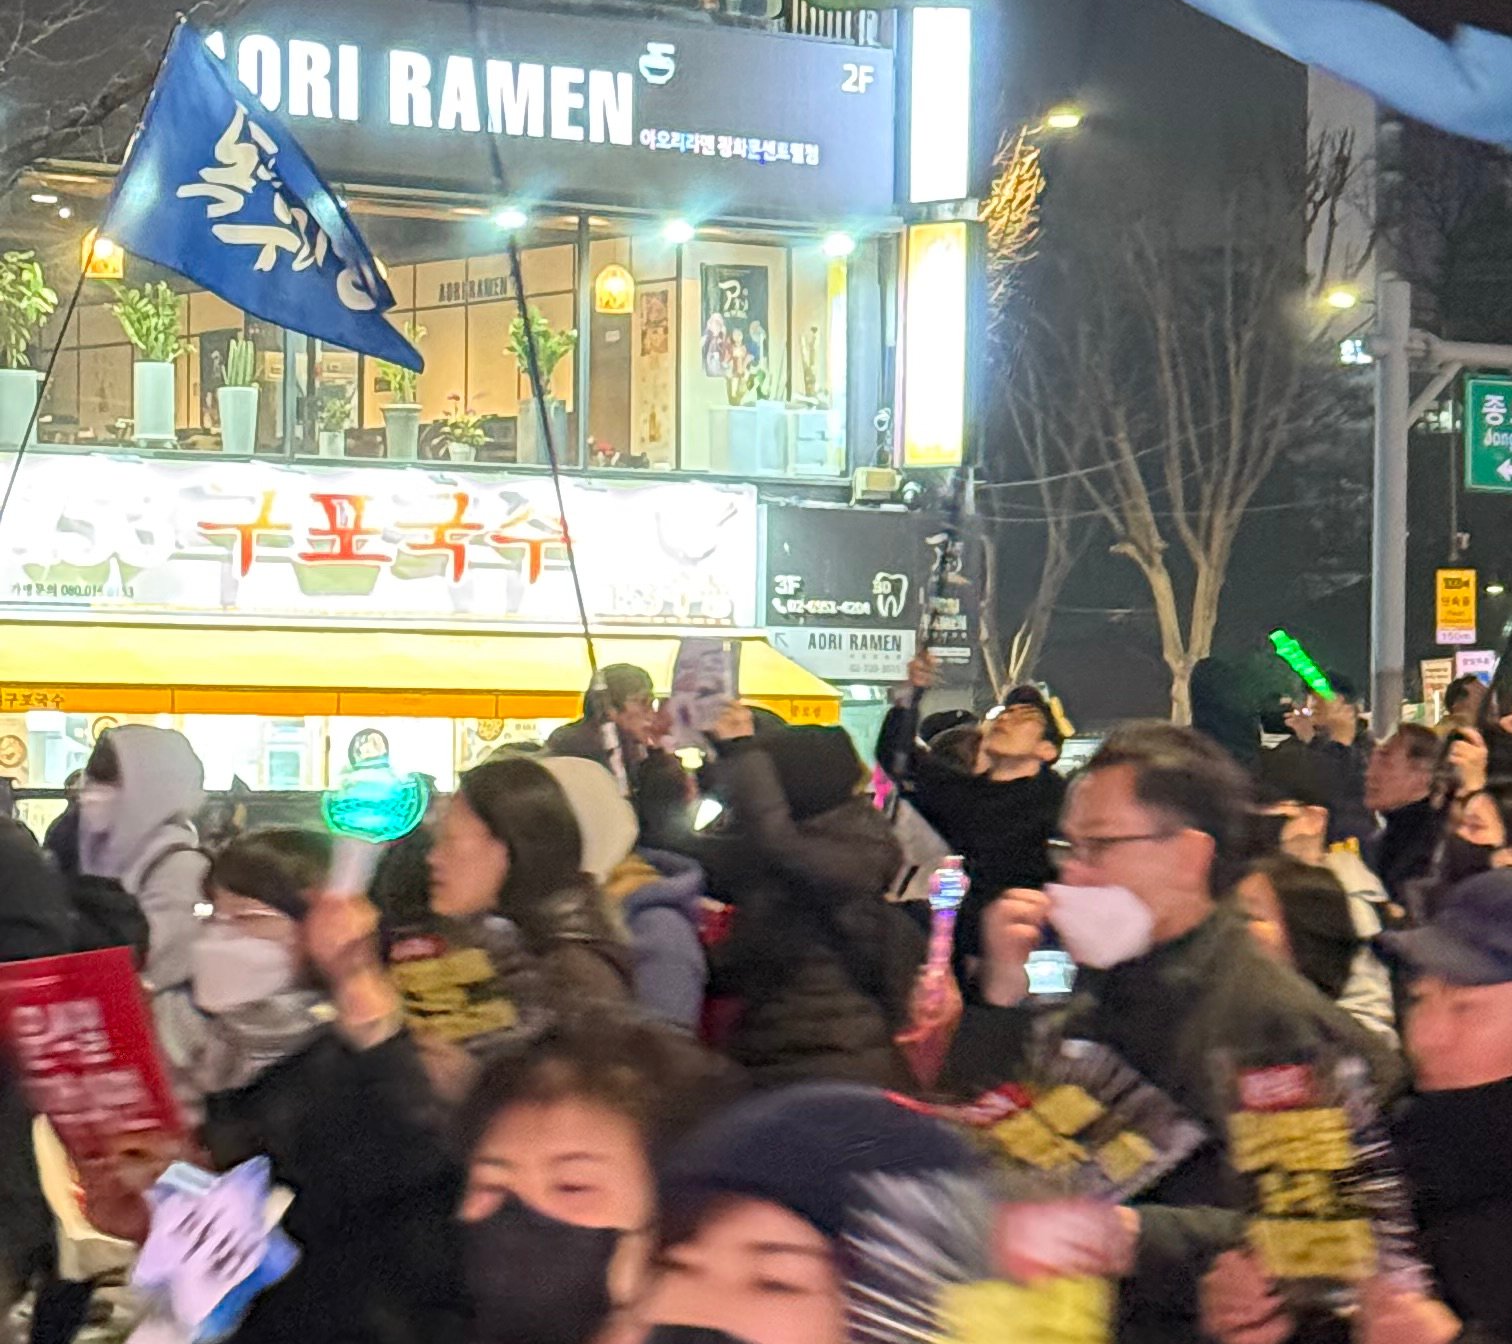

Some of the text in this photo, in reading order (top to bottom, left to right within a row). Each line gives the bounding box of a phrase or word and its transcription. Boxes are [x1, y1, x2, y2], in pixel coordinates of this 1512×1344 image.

[204, 31, 633, 146] ORI RAMEN
[840, 63, 873, 93] 2F
[197, 490, 577, 585] 구포국수
[774, 574, 802, 595] 3F
[808, 632, 902, 652] AORI RAMEN
